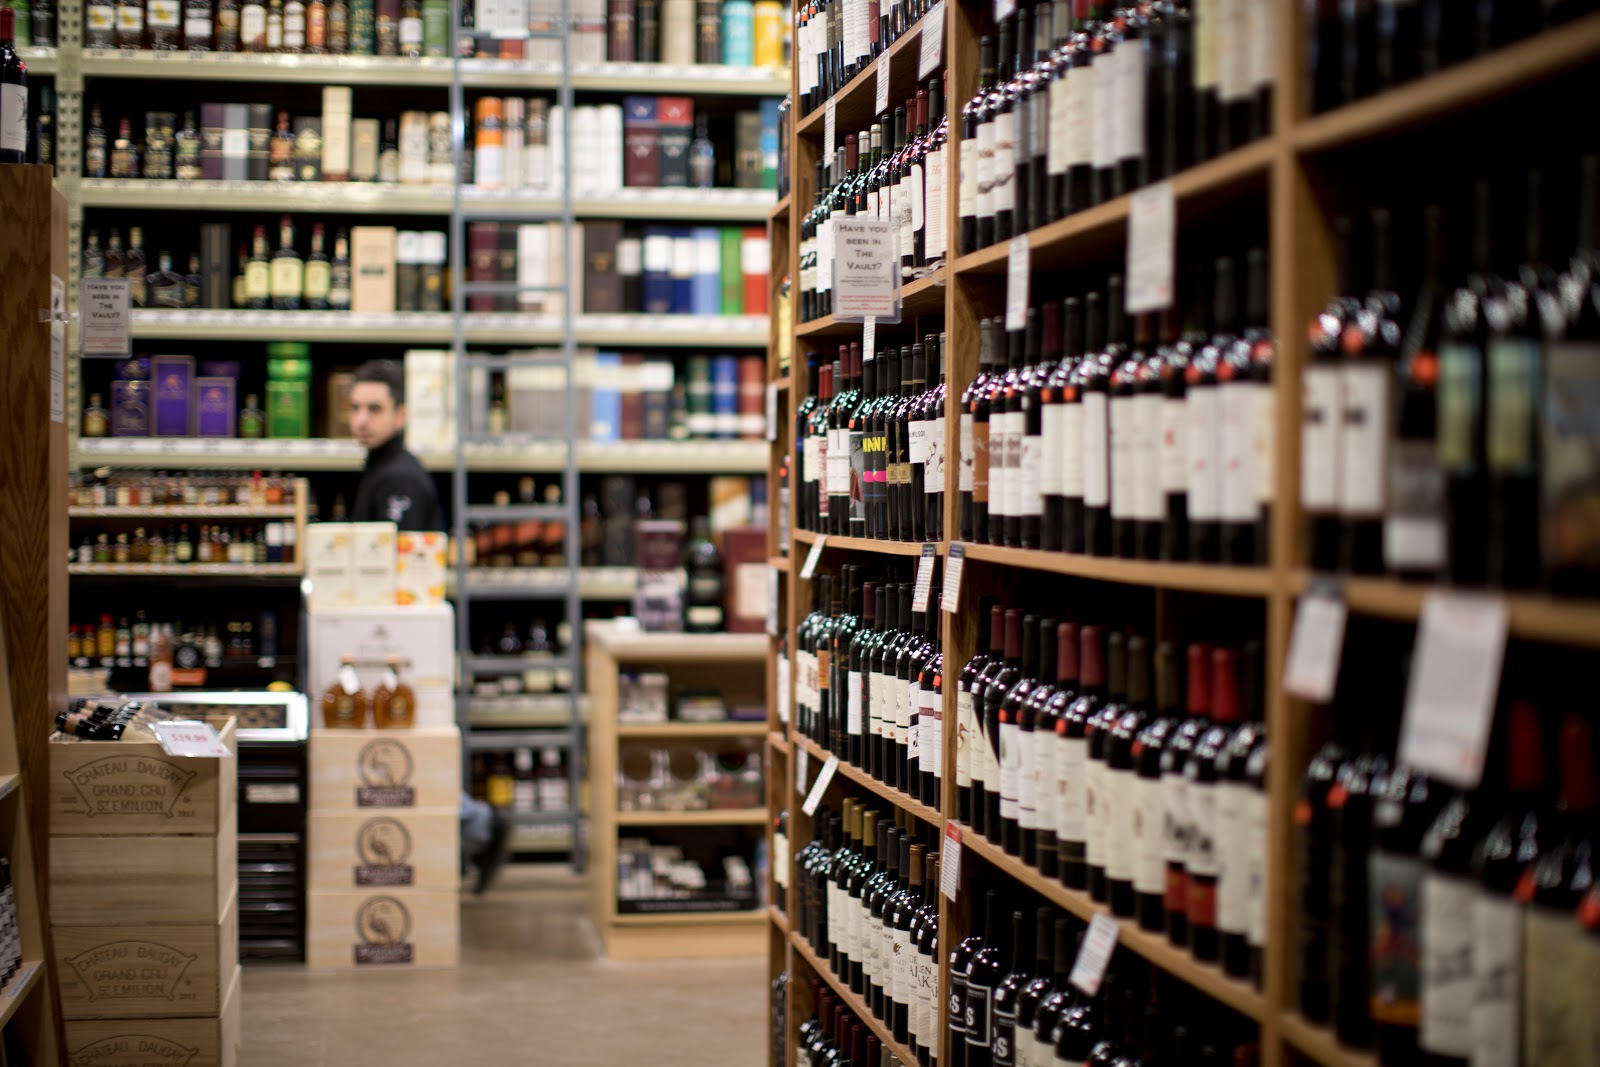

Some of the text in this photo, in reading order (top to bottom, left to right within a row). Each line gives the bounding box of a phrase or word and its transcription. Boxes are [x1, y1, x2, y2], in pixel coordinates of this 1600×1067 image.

[92, 784, 167, 797] GRAND CRU
[112, 800, 163, 811] EMILION
[93, 968, 168, 981] GRAND CRU
